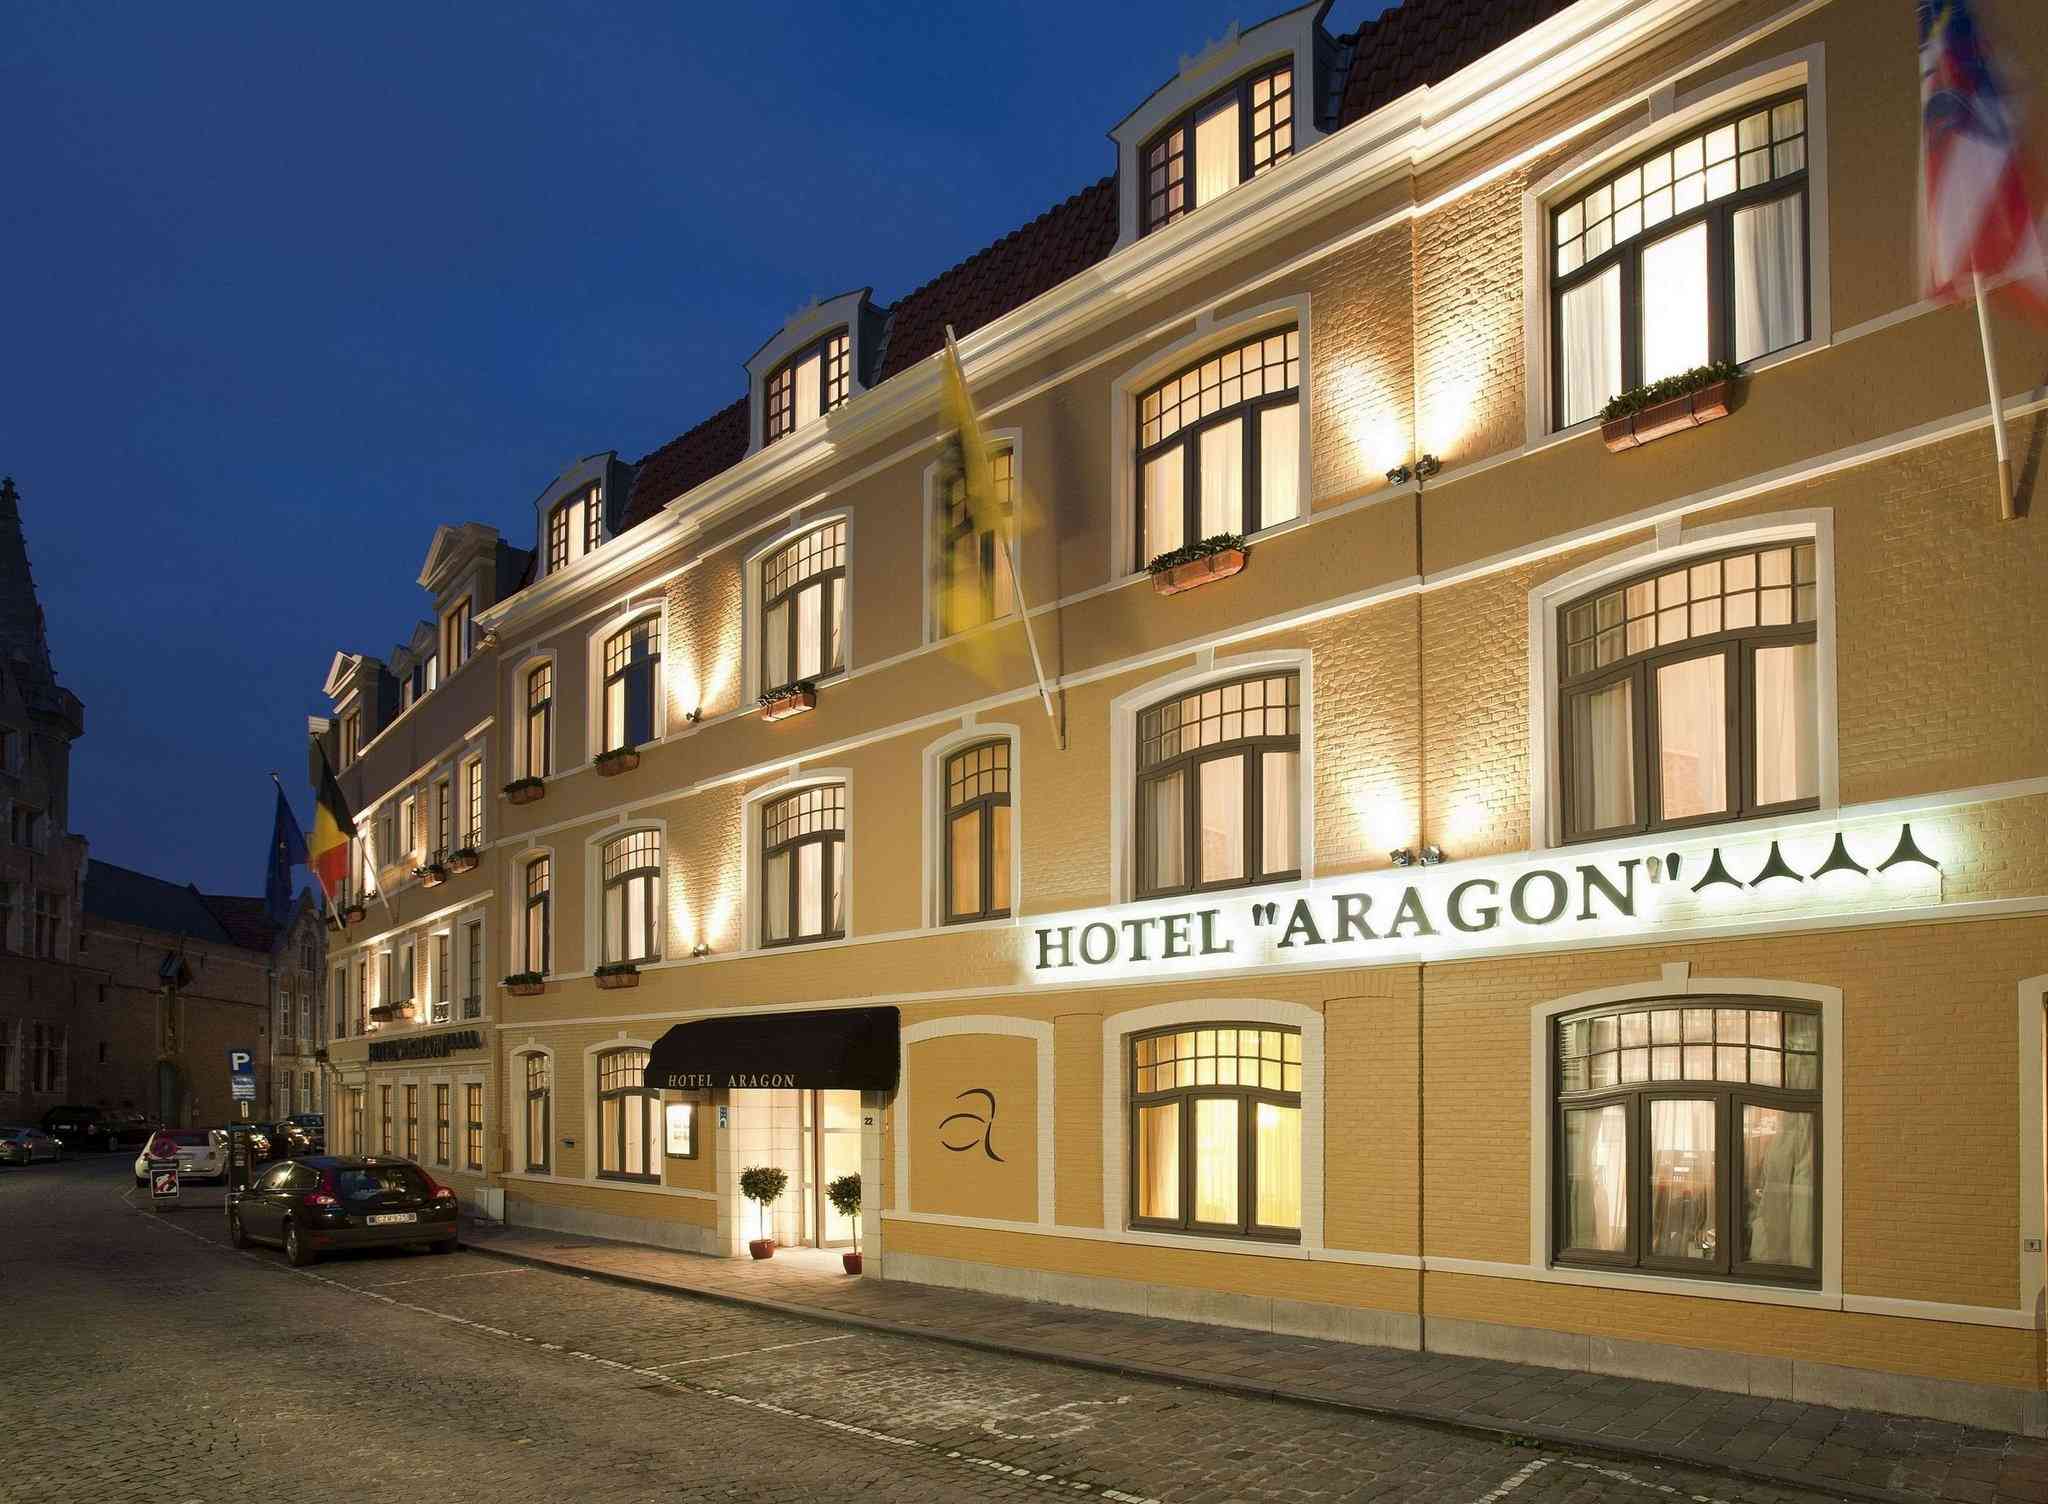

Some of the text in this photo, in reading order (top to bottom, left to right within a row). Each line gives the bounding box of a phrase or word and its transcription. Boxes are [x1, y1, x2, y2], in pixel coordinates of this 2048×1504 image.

[1035, 908, 1235, 970] HOTEL
[231, 1052, 250, 1071] P
[668, 1073, 795, 1088] HOTEL ARAGON
[864, 1117, 873, 1126] 22
